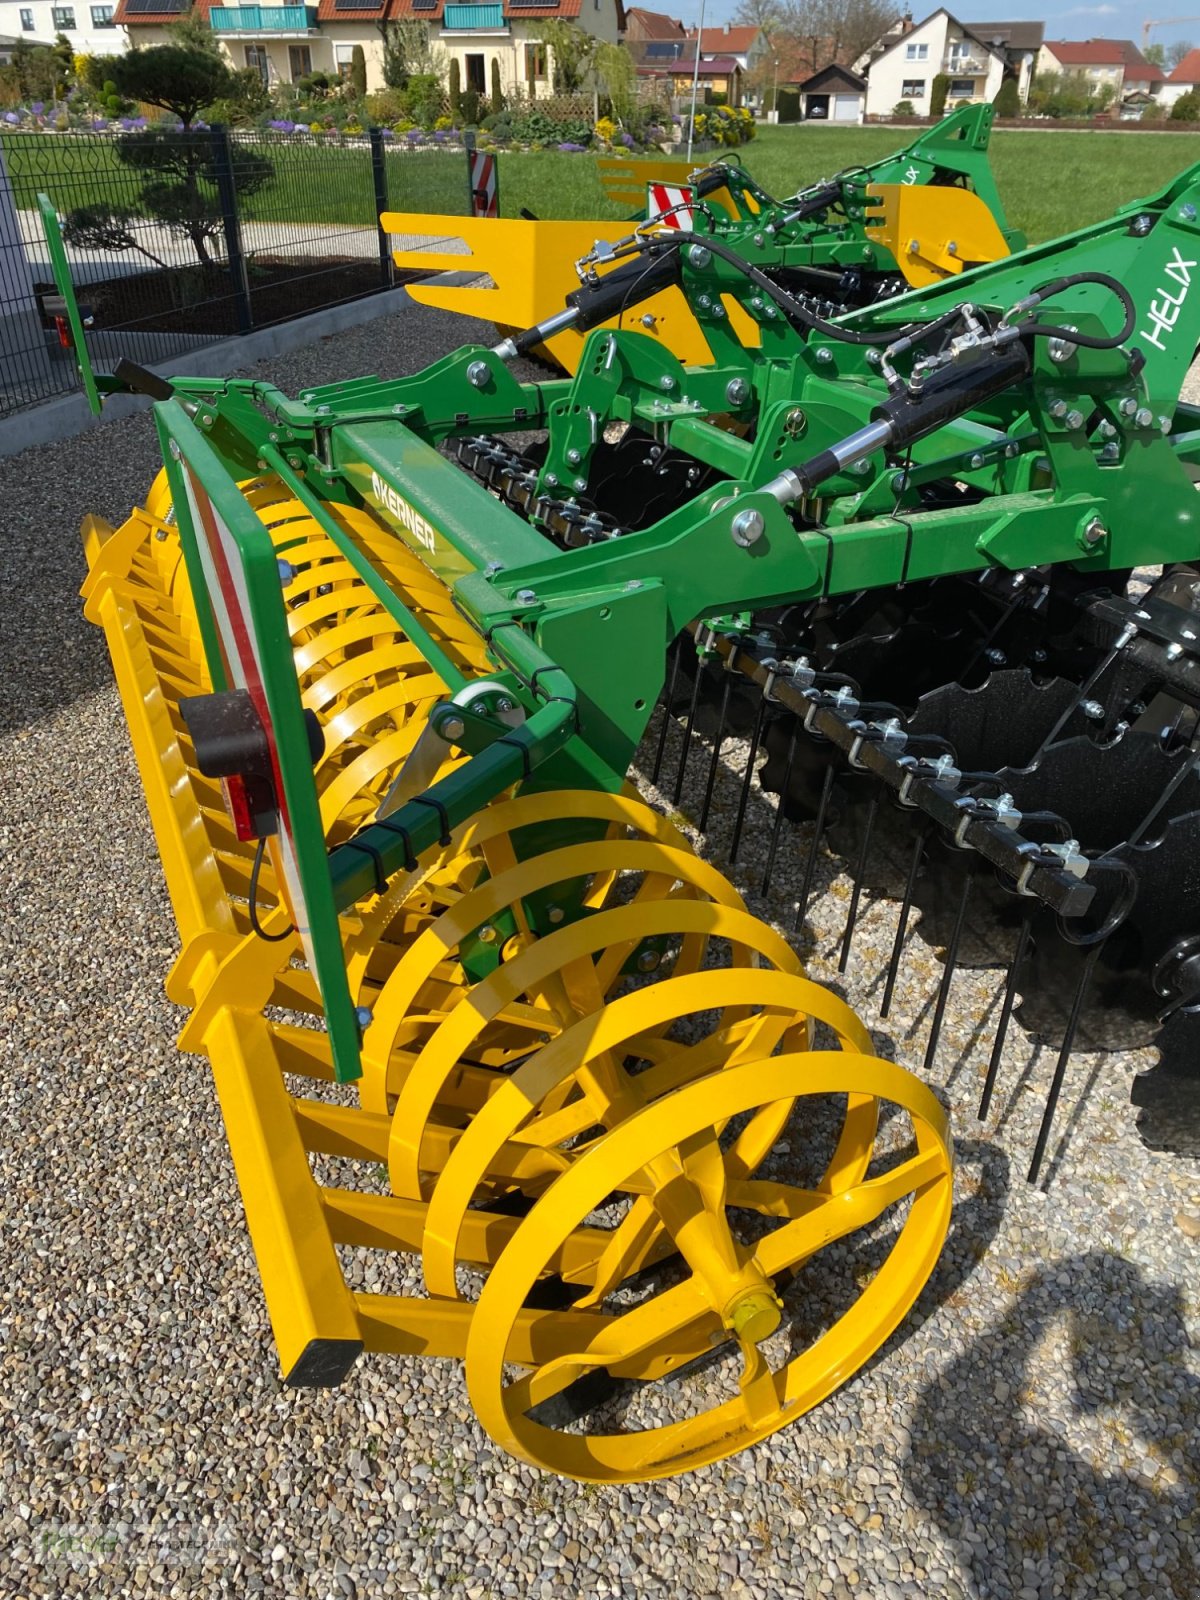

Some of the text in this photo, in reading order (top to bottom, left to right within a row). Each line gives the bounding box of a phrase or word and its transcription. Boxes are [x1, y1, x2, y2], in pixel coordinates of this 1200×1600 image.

[901, 166, 920, 185] LIX
[1140, 247, 1197, 351] HELIX
[380, 479, 435, 555] KERNER
